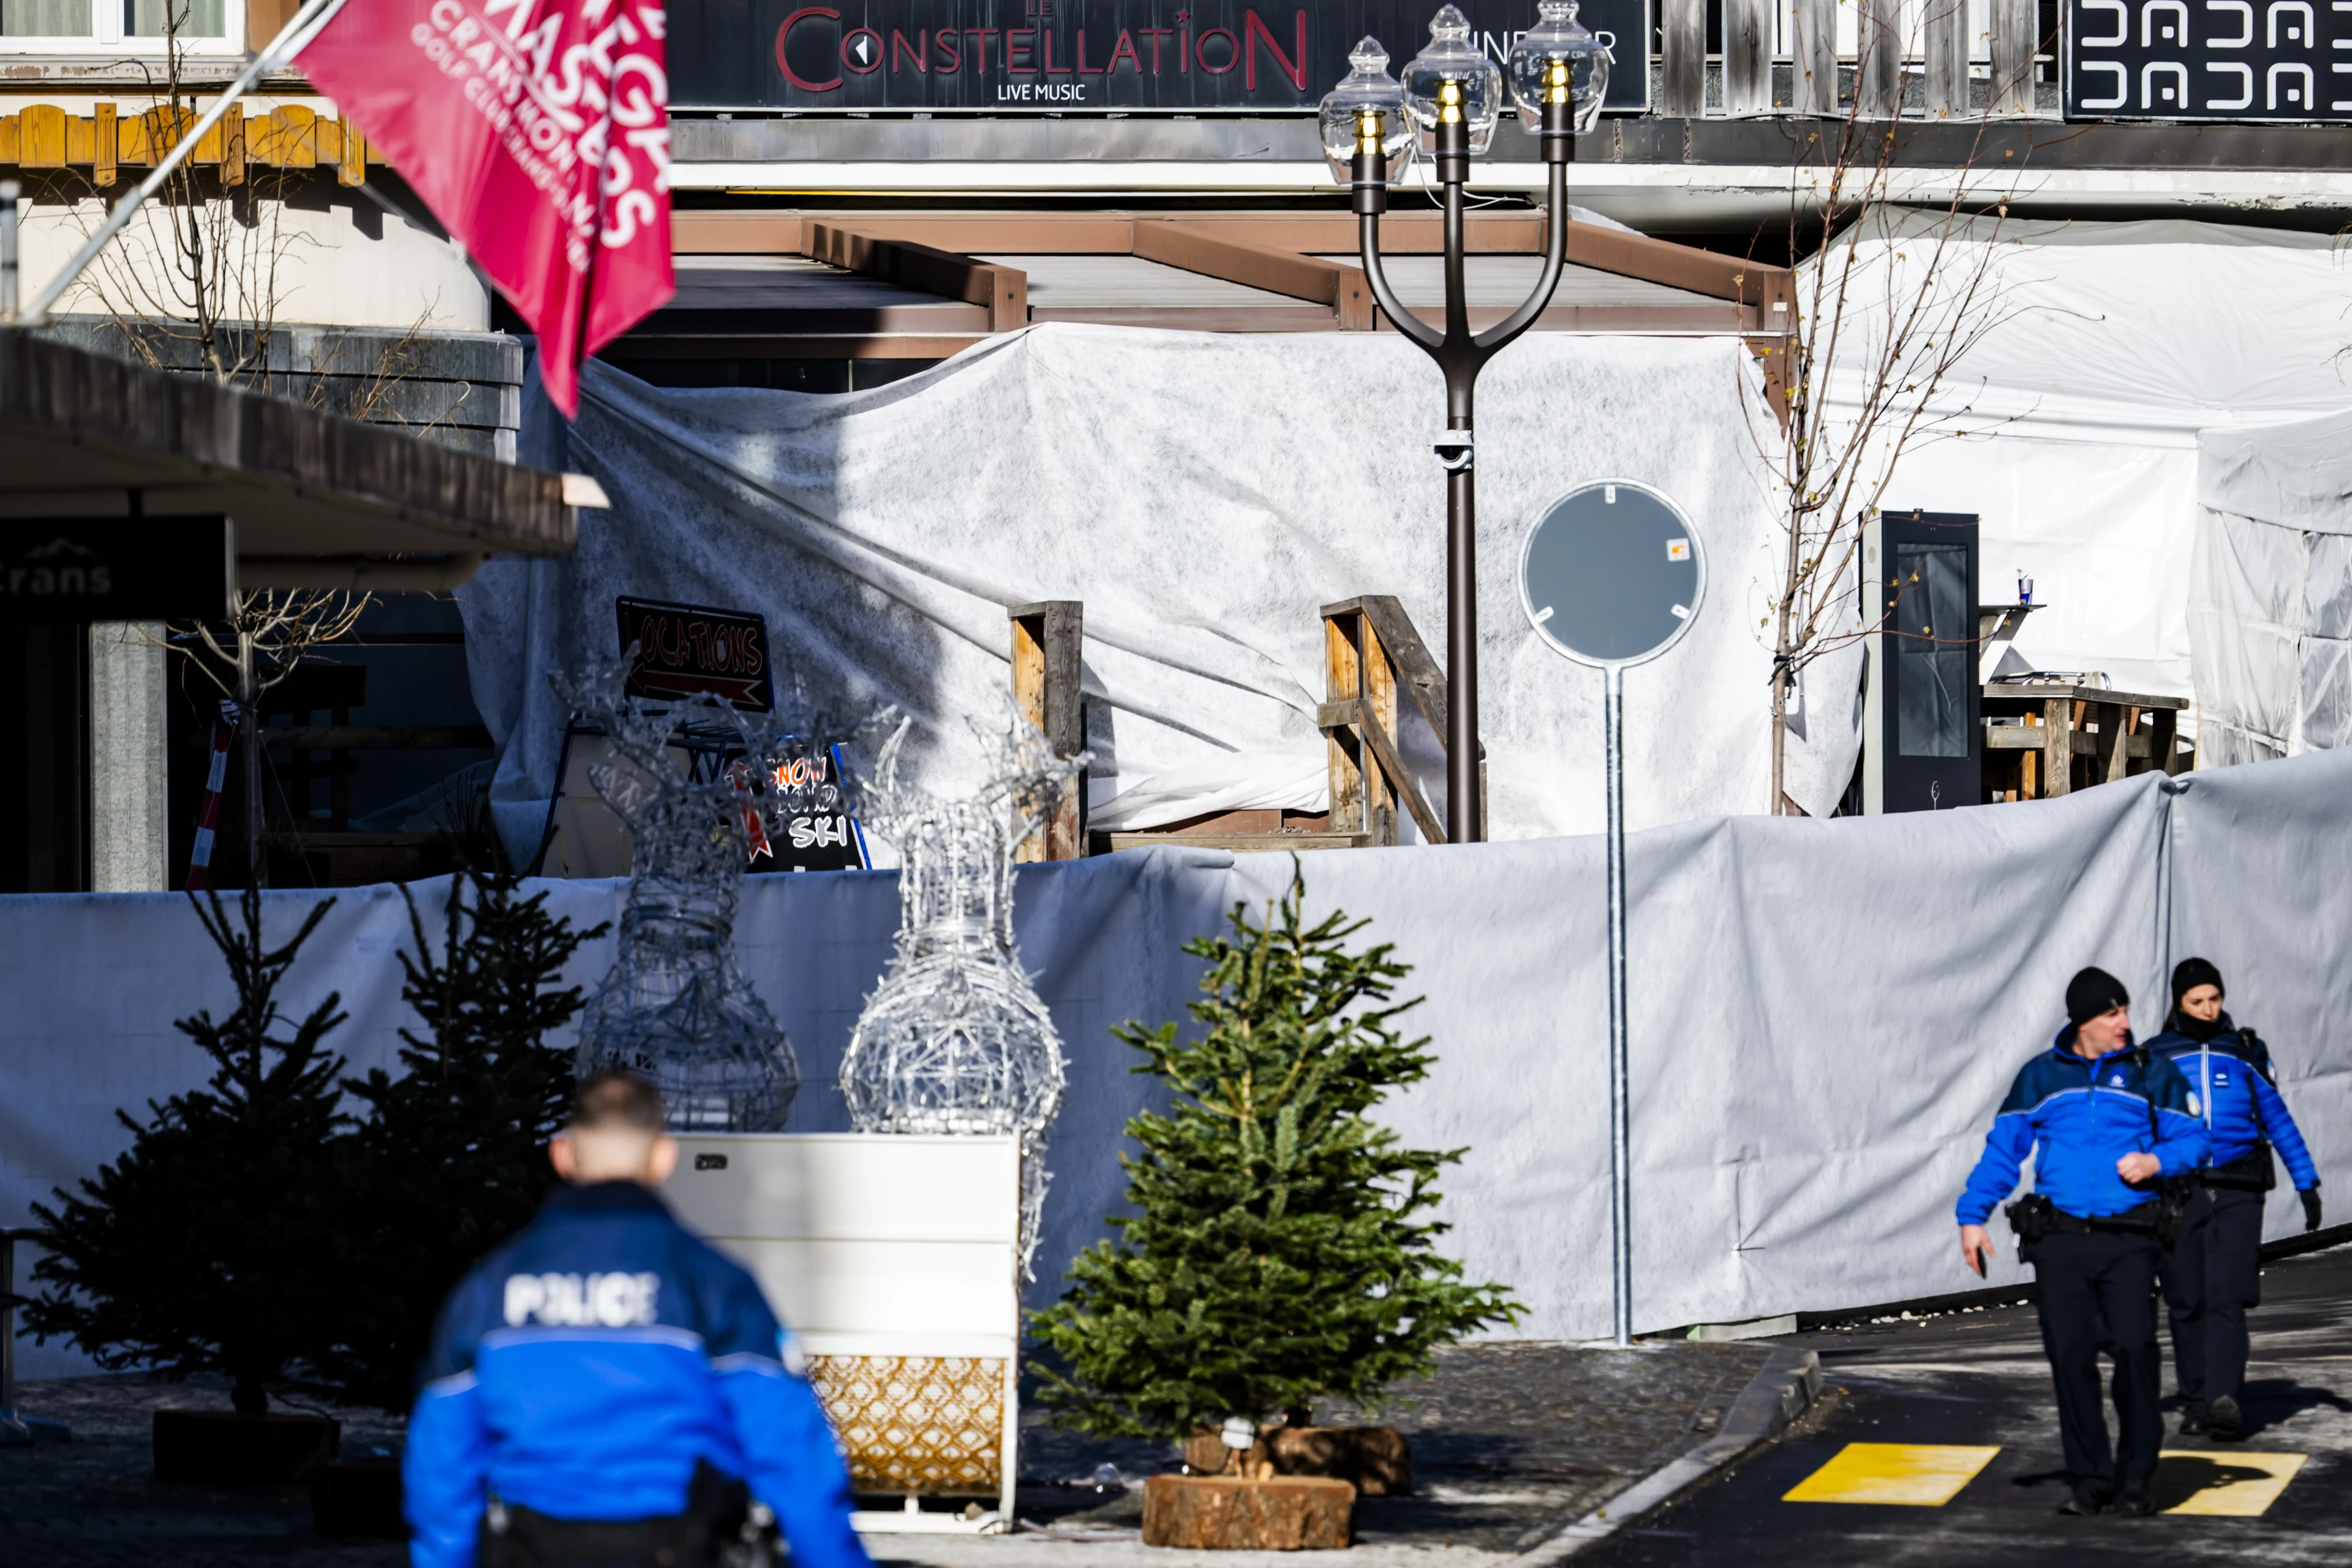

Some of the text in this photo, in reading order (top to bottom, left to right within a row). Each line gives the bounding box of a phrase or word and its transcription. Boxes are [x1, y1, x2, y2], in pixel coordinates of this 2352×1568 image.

[998, 84, 1086, 100] LIVE MUSIC
[0, 561, 111, 595] rans
[788, 815, 848, 848] SKI
[503, 1272, 661, 1327] POLICE
